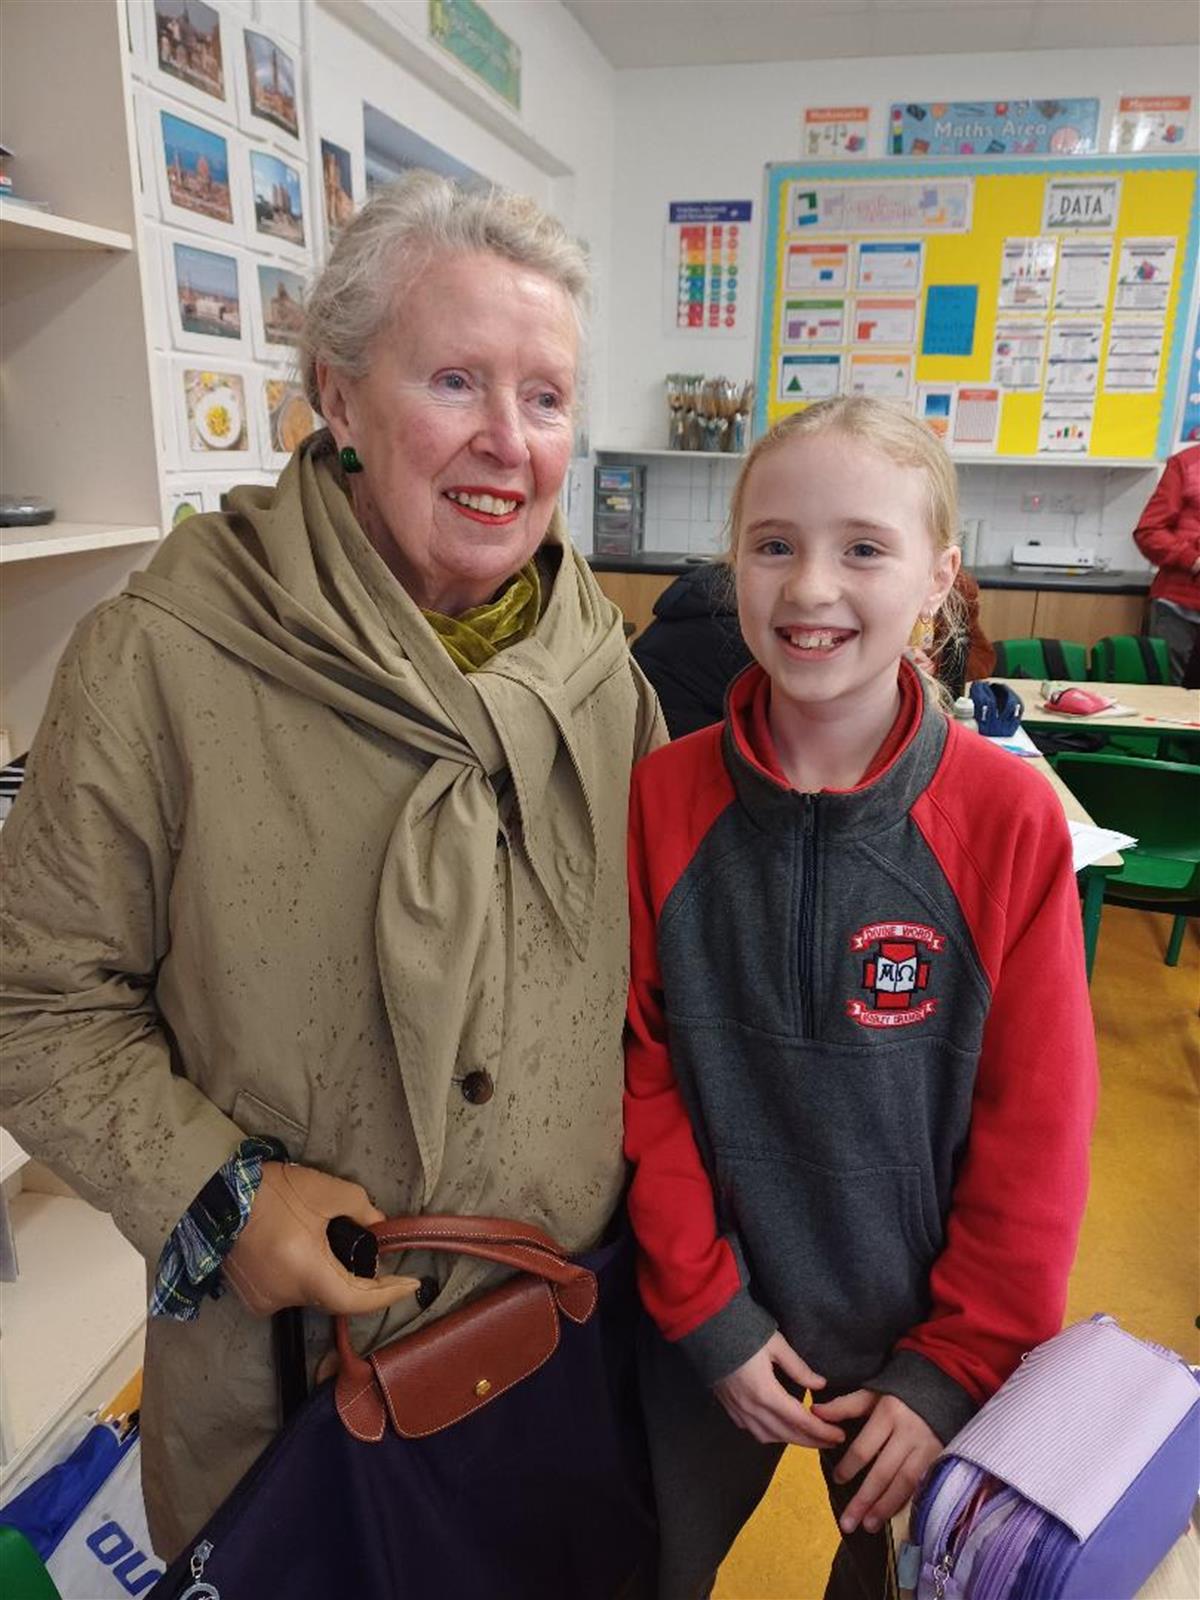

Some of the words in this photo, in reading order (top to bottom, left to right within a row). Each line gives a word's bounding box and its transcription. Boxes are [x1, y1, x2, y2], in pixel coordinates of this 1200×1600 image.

[935, 121, 993, 137] Maths
[1002, 121, 1047, 136] Area
[1060, 195, 1103, 215] DATA
[865, 925, 897, 939] DIVINE
[902, 925, 932, 940] WORD
